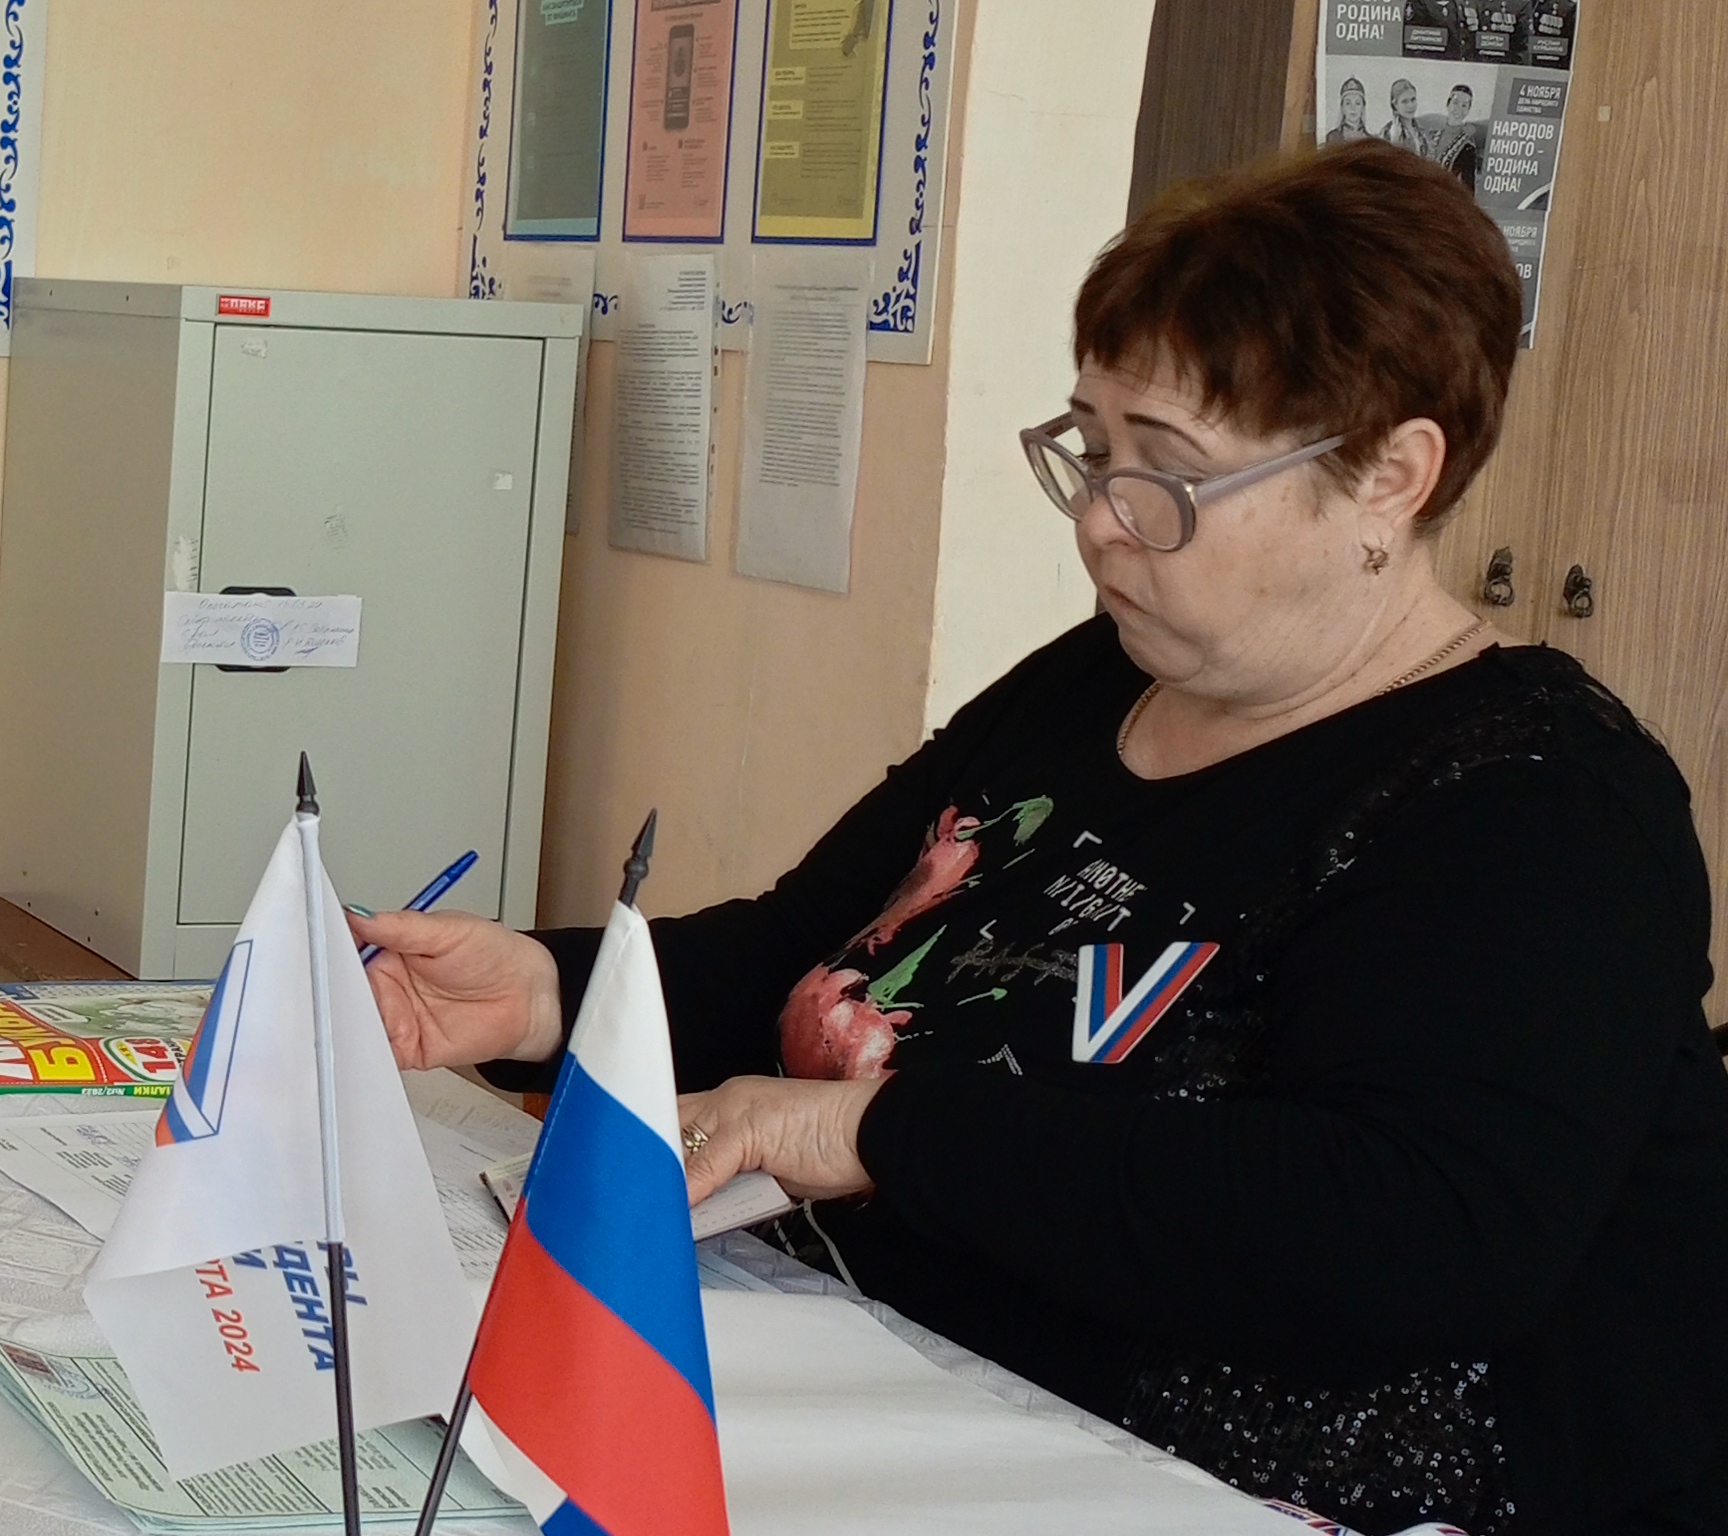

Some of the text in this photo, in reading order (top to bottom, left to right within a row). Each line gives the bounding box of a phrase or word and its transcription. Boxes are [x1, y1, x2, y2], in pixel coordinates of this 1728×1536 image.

[1336, 4, 1401, 23] РОДИНА
[1336, 22, 1384, 40] ОДНА!
[1520, 84, 1561, 99] 4 НОЯБРЯ
[1492, 120, 1554, 141] НАРОДОВ
[1489, 139, 1535, 157] МНОГО
[1487, 158, 1538, 176] РОДИНА
[1484, 176, 1521, 193] ОДНА!
[125, 1037, 178, 1075] 148
[212, 1308, 260, 1374] 2024
